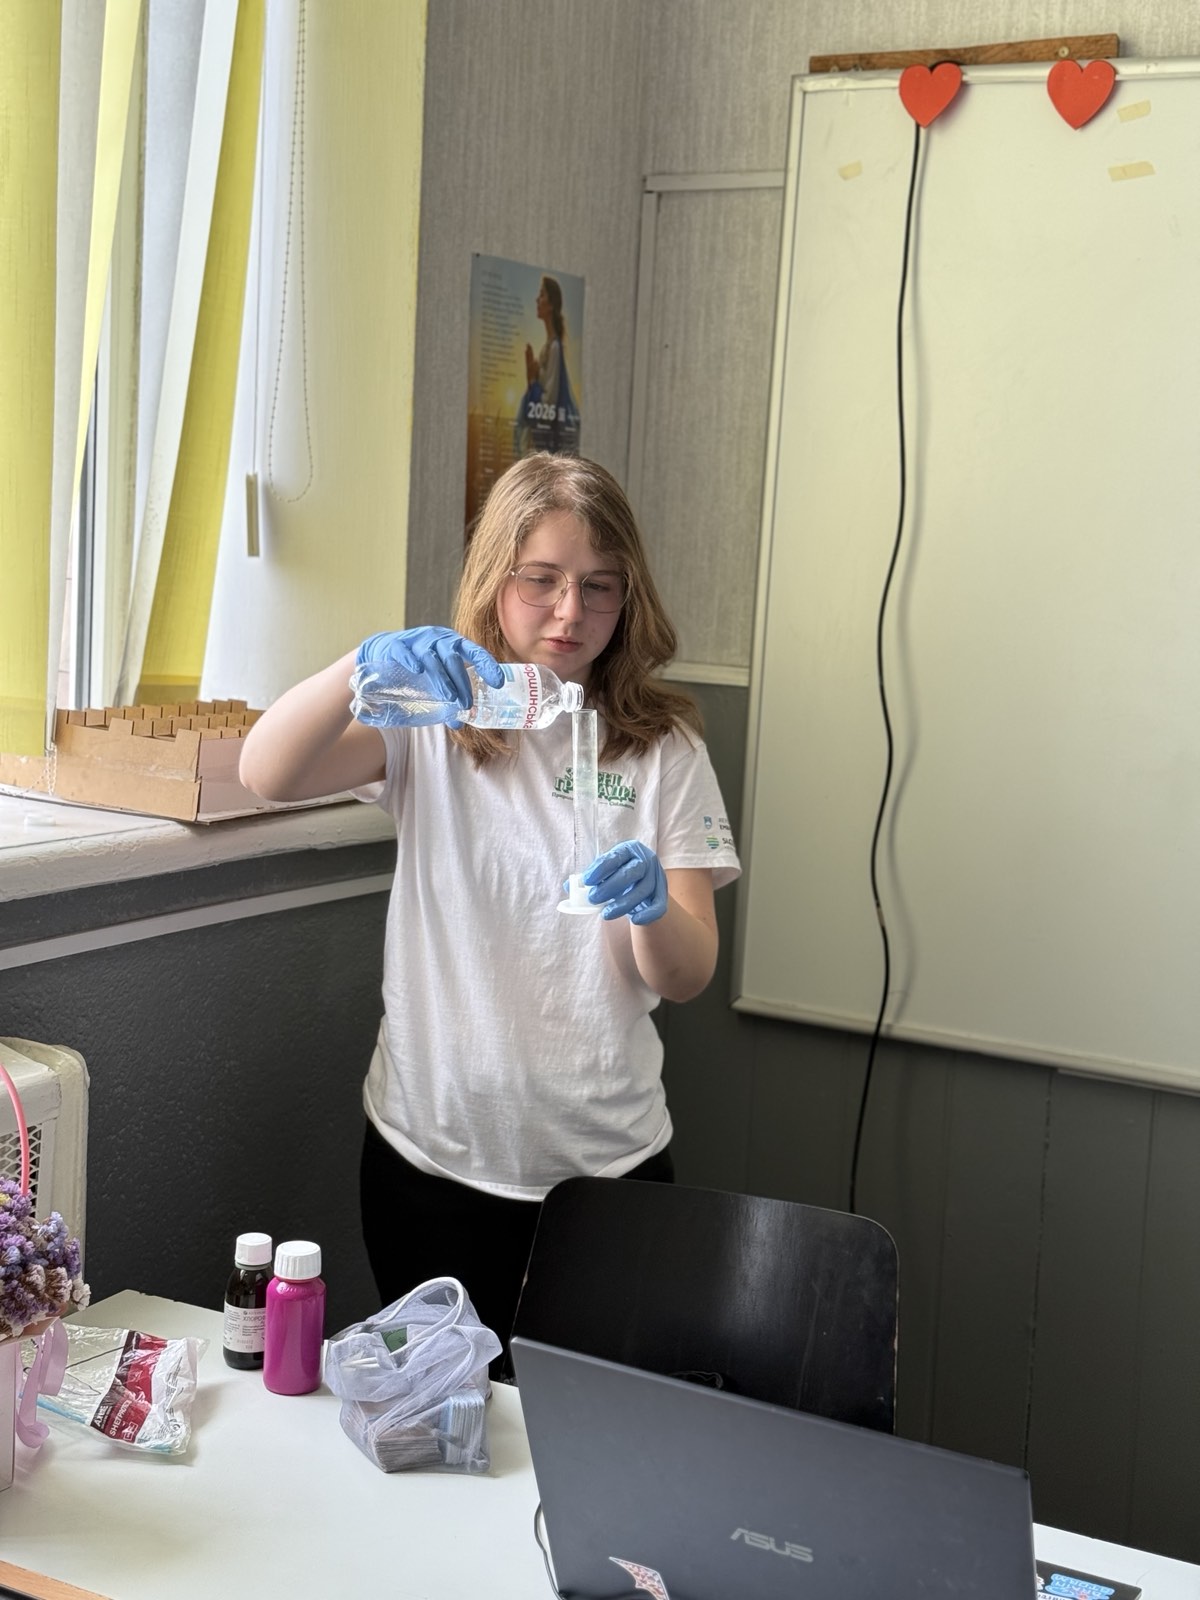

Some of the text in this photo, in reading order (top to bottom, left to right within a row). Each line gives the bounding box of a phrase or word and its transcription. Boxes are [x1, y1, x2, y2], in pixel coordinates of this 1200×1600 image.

[527, 401, 557, 421] 2026
[523, 663, 538, 729] оршинська
[730, 1528, 813, 1562] ASUS
